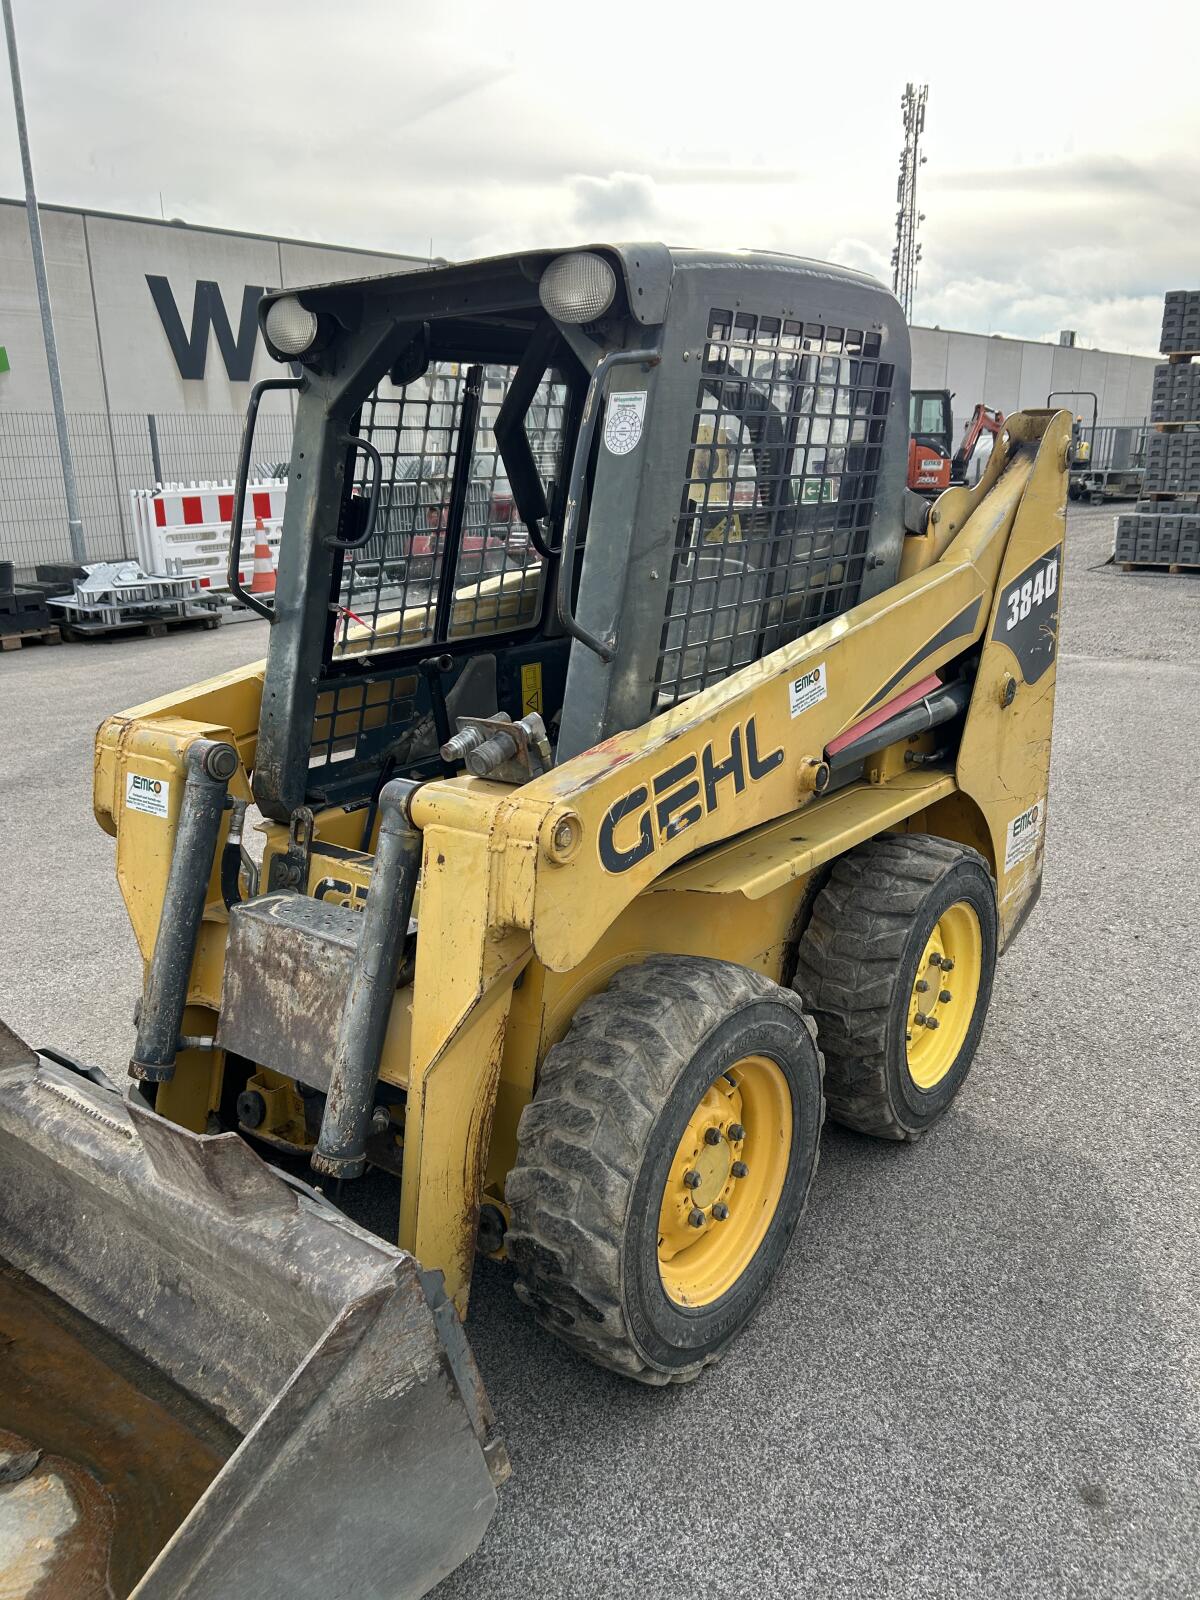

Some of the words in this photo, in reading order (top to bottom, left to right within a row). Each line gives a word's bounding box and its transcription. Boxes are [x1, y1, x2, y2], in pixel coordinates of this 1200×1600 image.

[144, 274, 303, 381] W
[1006, 559, 1058, 631] 3840
[794, 668, 821, 694] EMKO
[133, 775, 162, 794] EMKO
[597, 714, 785, 874] GEHL
[1012, 805, 1039, 837] EMKO
